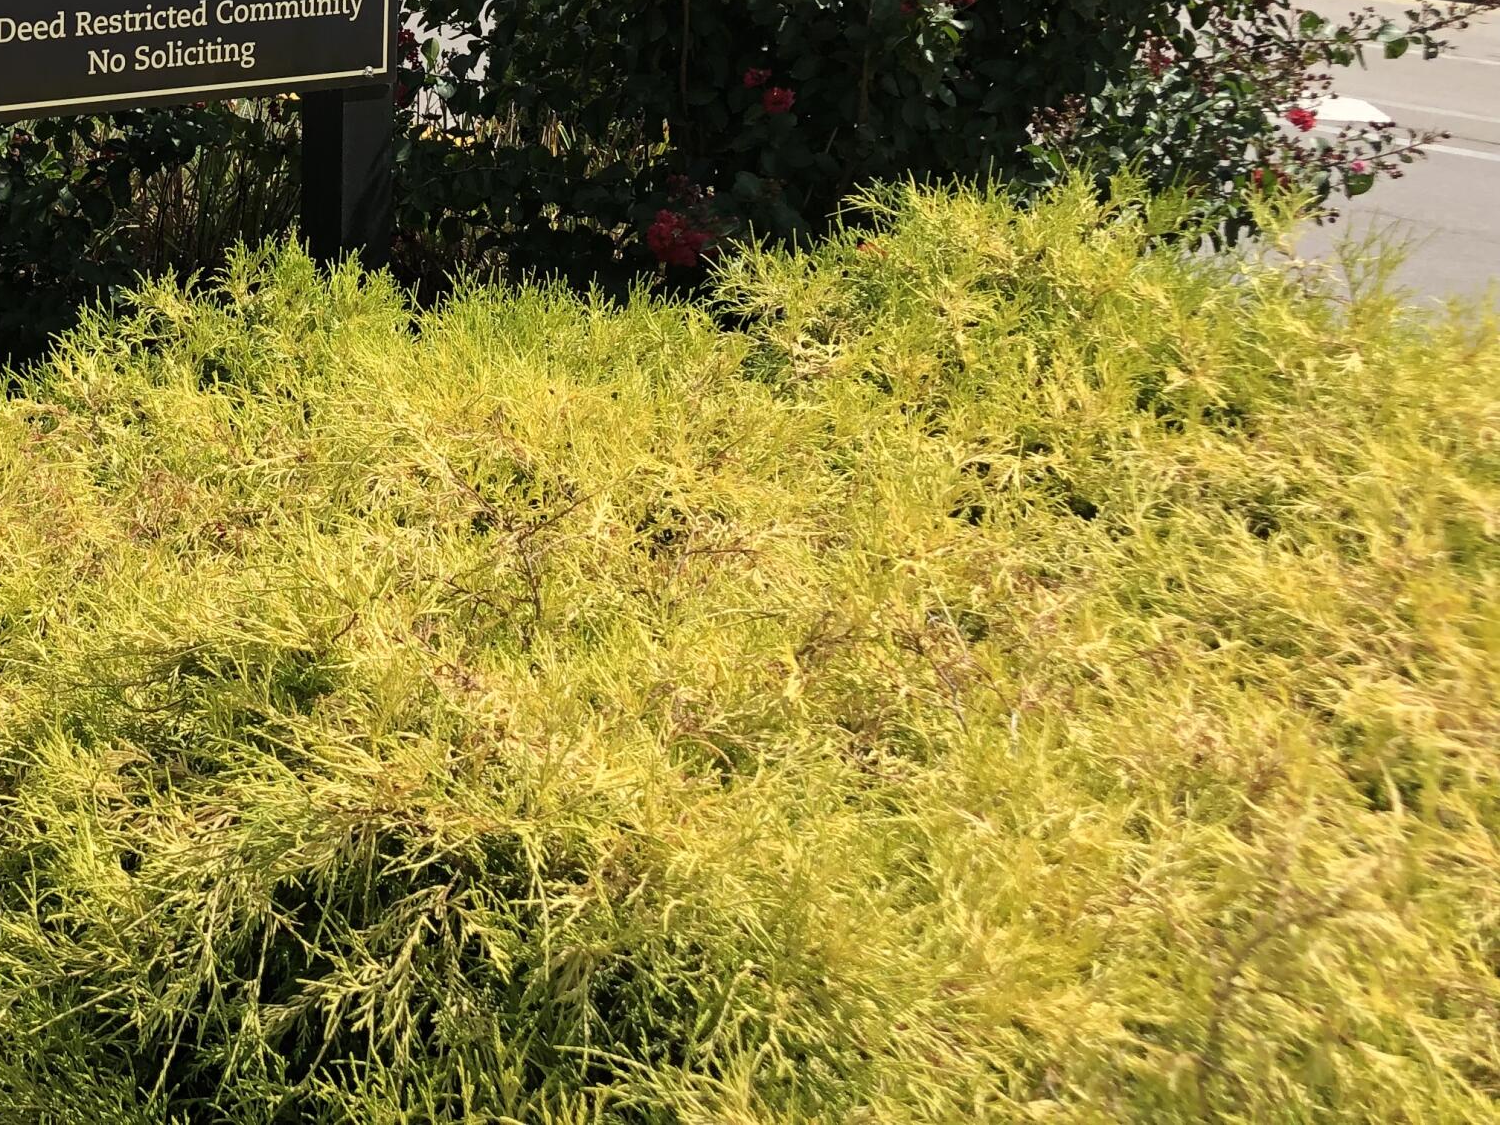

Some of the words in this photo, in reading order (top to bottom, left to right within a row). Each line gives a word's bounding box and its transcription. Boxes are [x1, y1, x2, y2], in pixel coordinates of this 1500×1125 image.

[75, 0, 208, 37] Restricted
[87, 48, 126, 75] No
[134, 36, 256, 71] Soliciting
